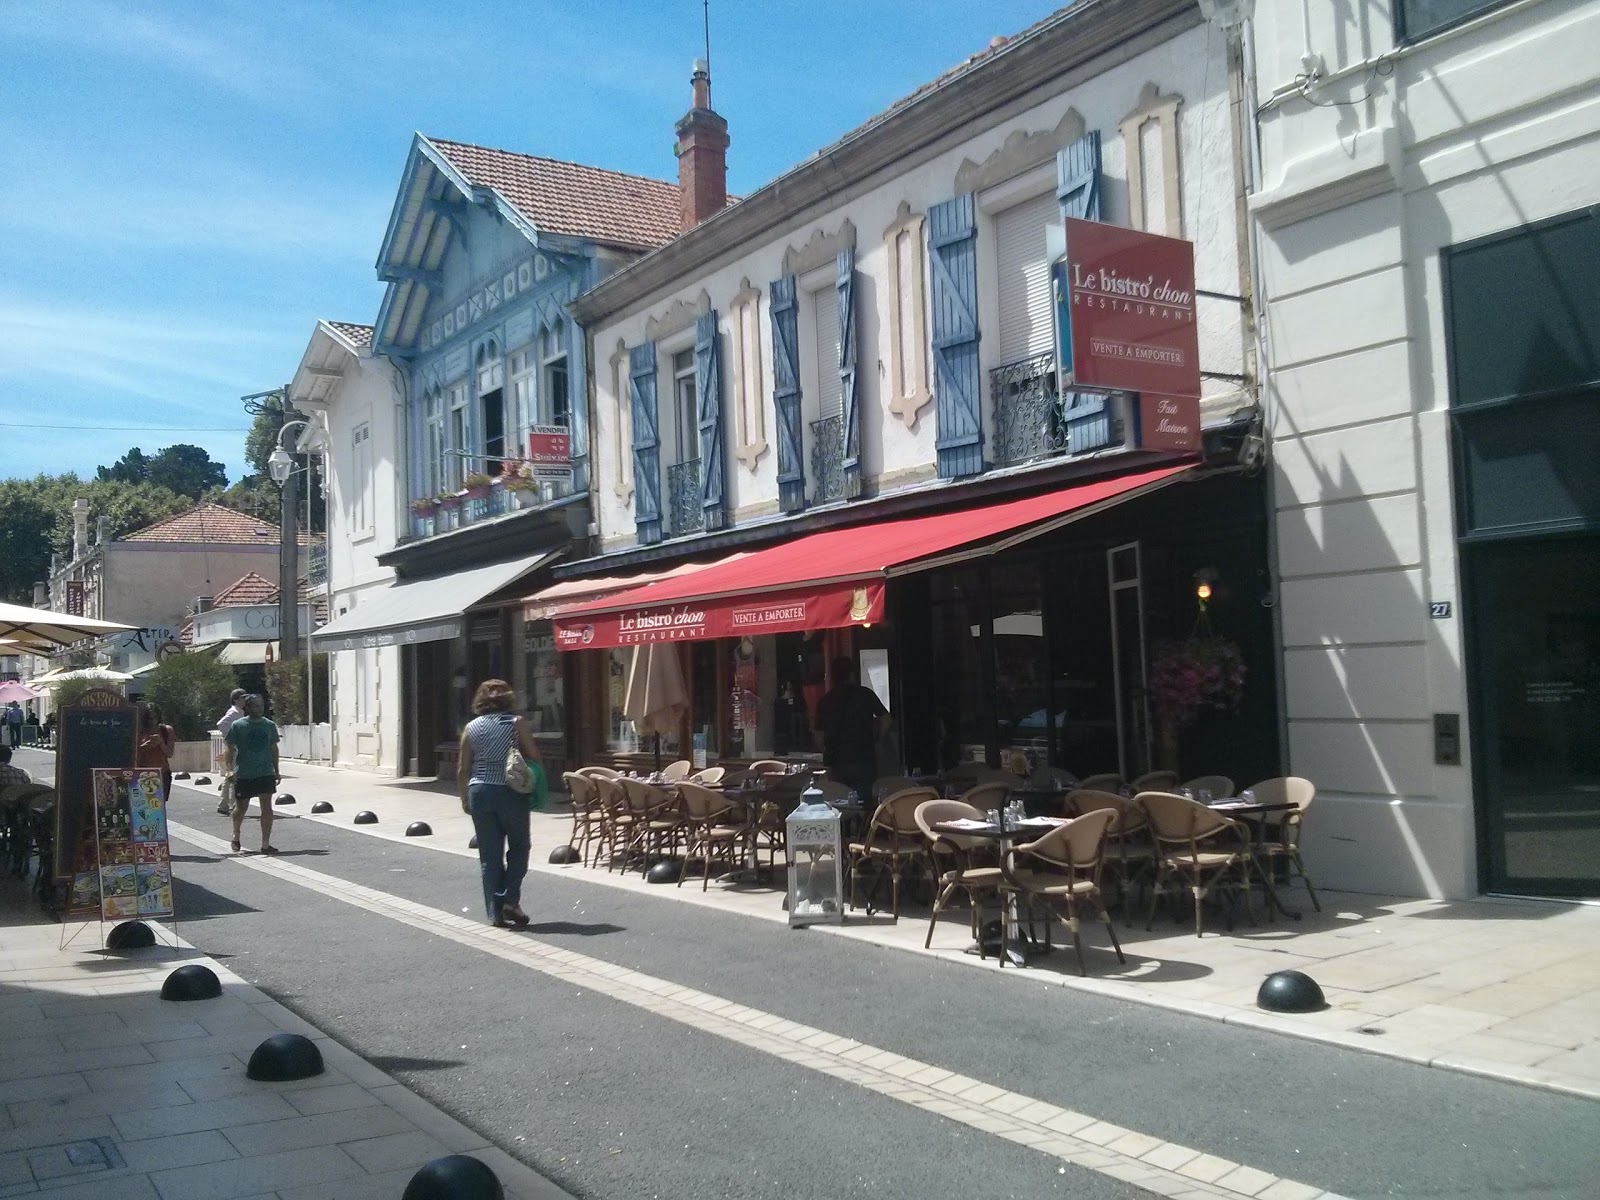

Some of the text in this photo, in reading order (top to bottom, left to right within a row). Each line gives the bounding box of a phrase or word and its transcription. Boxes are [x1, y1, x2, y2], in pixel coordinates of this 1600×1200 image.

[1073, 264, 1096, 289] Le
[1074, 294, 1192, 322] RESTAURANT
[1093, 342, 1182, 363] VENTE A EMPORTER
[1157, 400, 1177, 415] Fait
[1155, 418, 1189, 434] Maison
[734, 607, 803, 624] VENTE A EMPORTER
[1431, 604, 1447, 616] 27
[244, 609, 280, 630] Caf
[620, 613, 634, 630] Le
[618, 628, 705, 643] RESTAURANT
[81, 692, 120, 707] BISTROT
